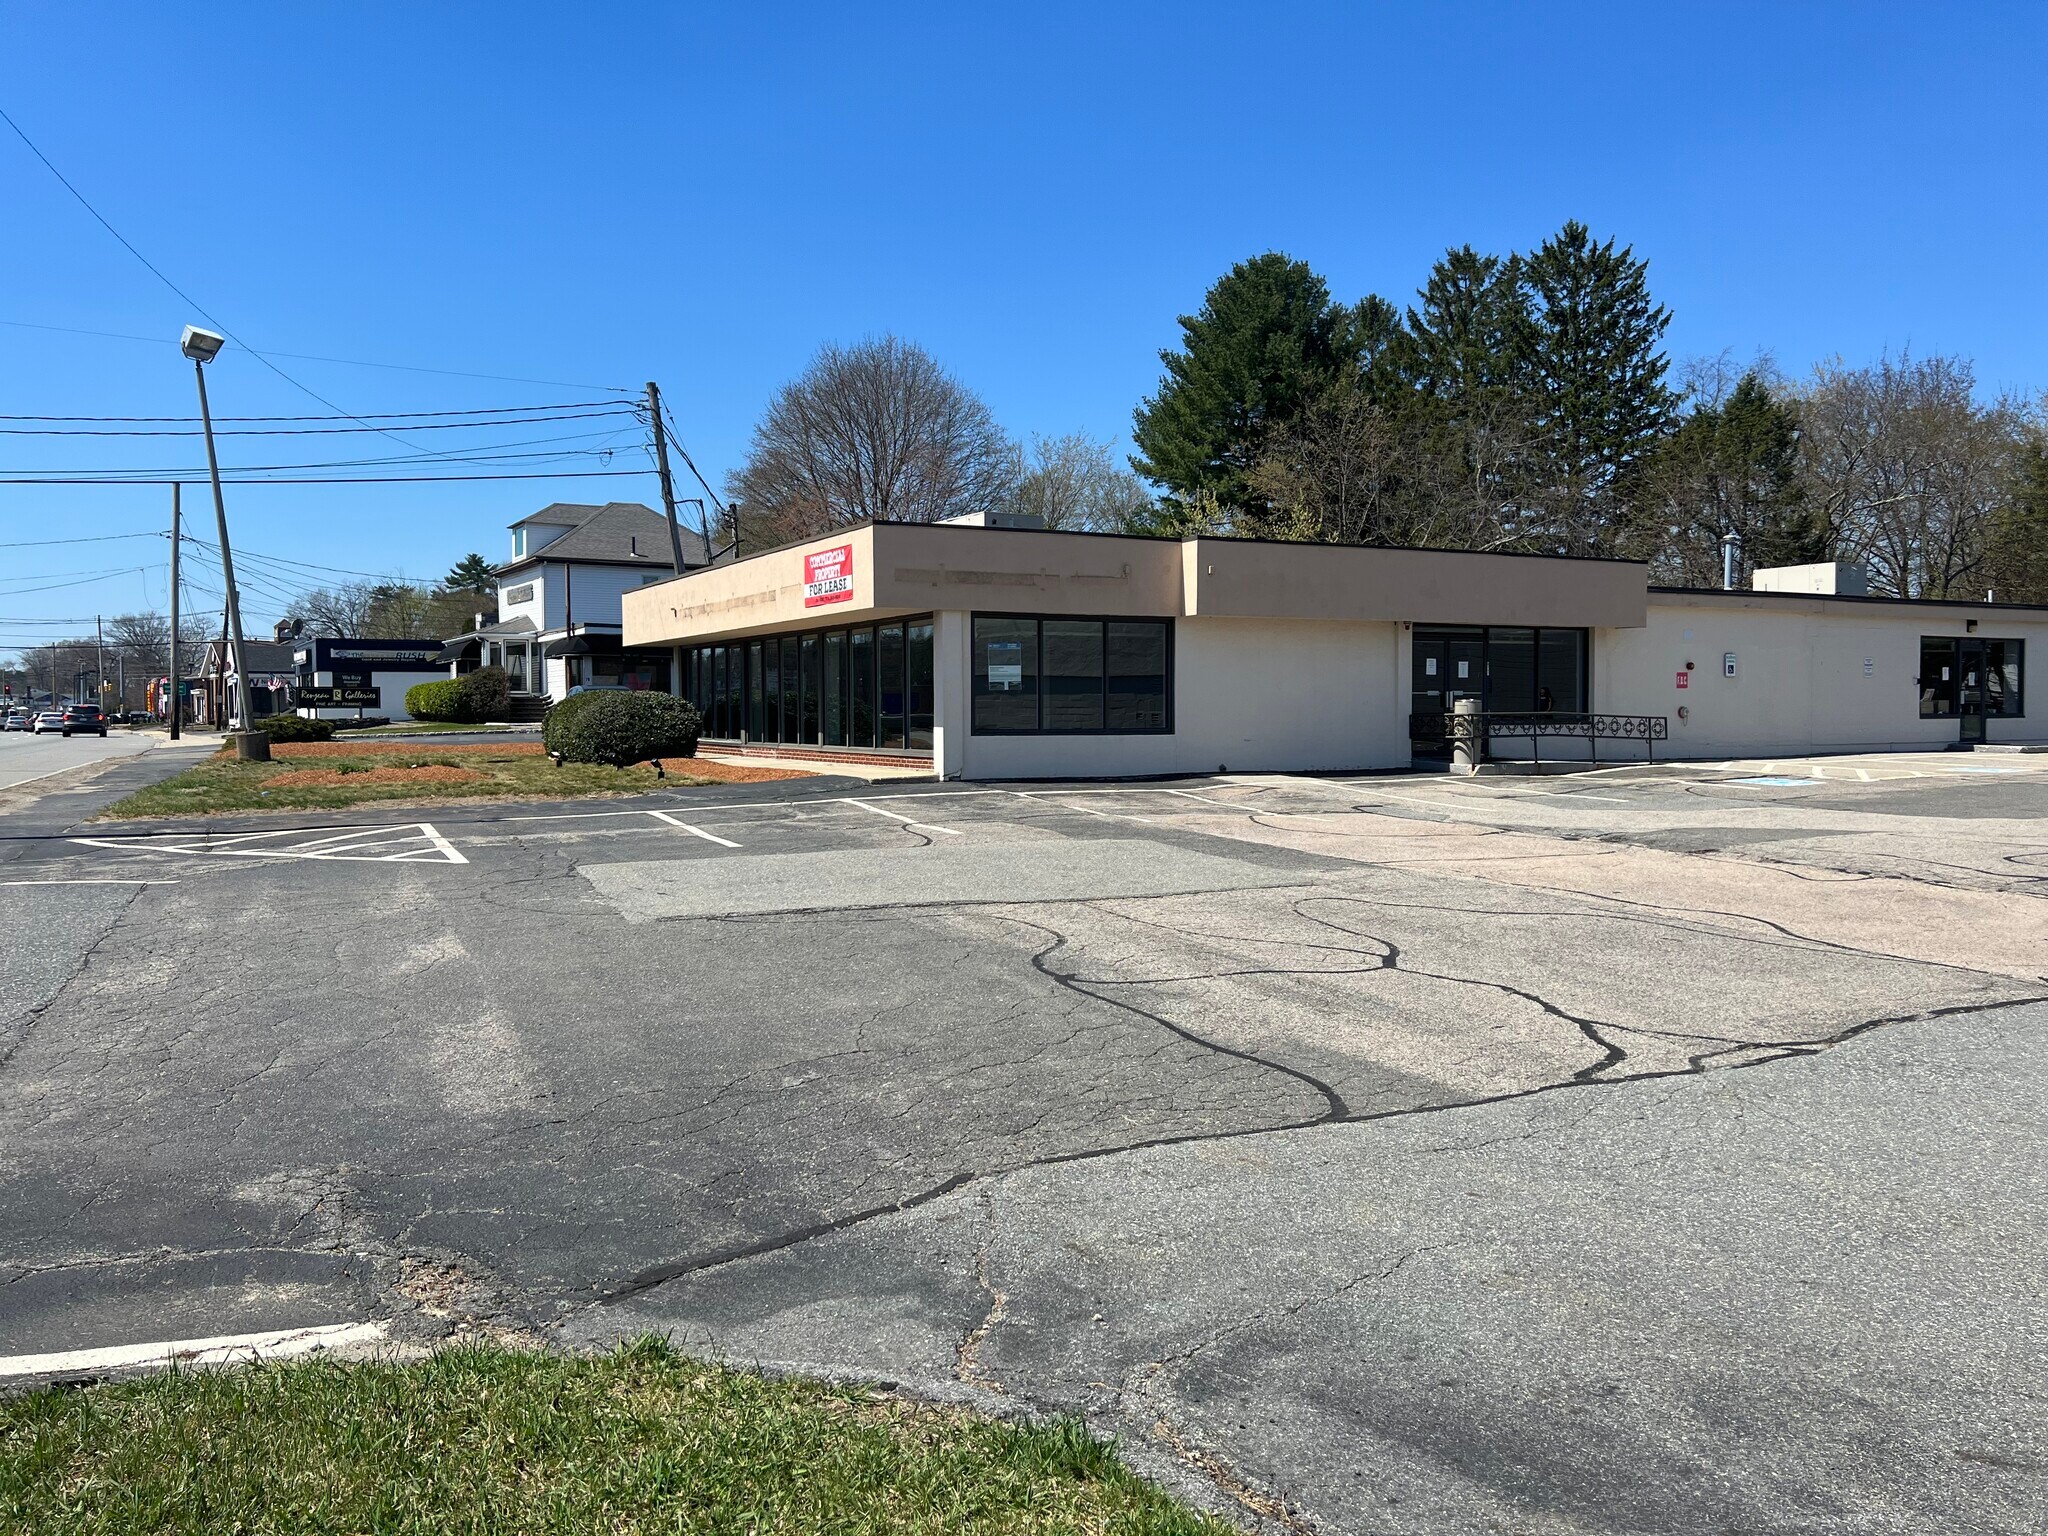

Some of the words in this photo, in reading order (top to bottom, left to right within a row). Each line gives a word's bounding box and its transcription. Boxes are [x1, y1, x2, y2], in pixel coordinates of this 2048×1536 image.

[814, 564, 841, 582] PROPERTY
[809, 584, 823, 597] FOR
[824, 578, 847, 593] LEASE
[395, 651, 426, 659] RUSH
[345, 690, 376, 700] Galleries
